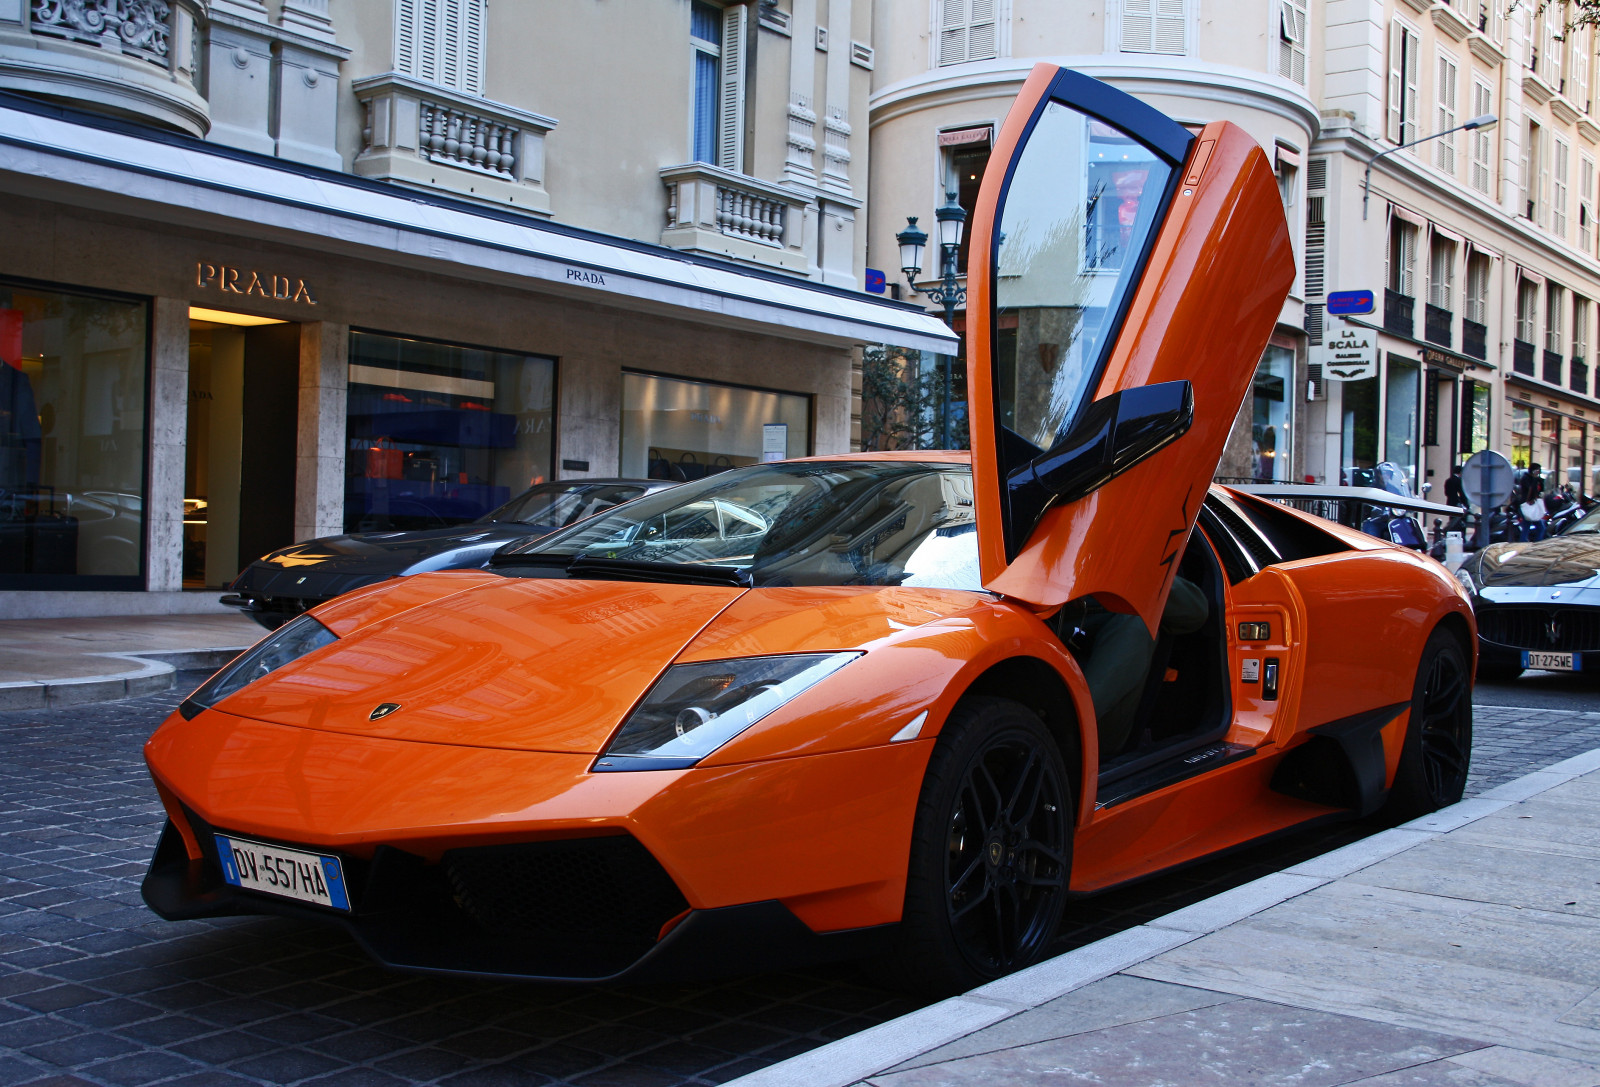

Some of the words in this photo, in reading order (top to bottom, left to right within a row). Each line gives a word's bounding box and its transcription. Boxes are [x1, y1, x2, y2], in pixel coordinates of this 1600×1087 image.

[197, 262, 319, 305] PRADA
[566, 268, 606, 286] PRADA
[1342, 330, 1355, 338] LA
[1328, 340, 1369, 350] SCALA
